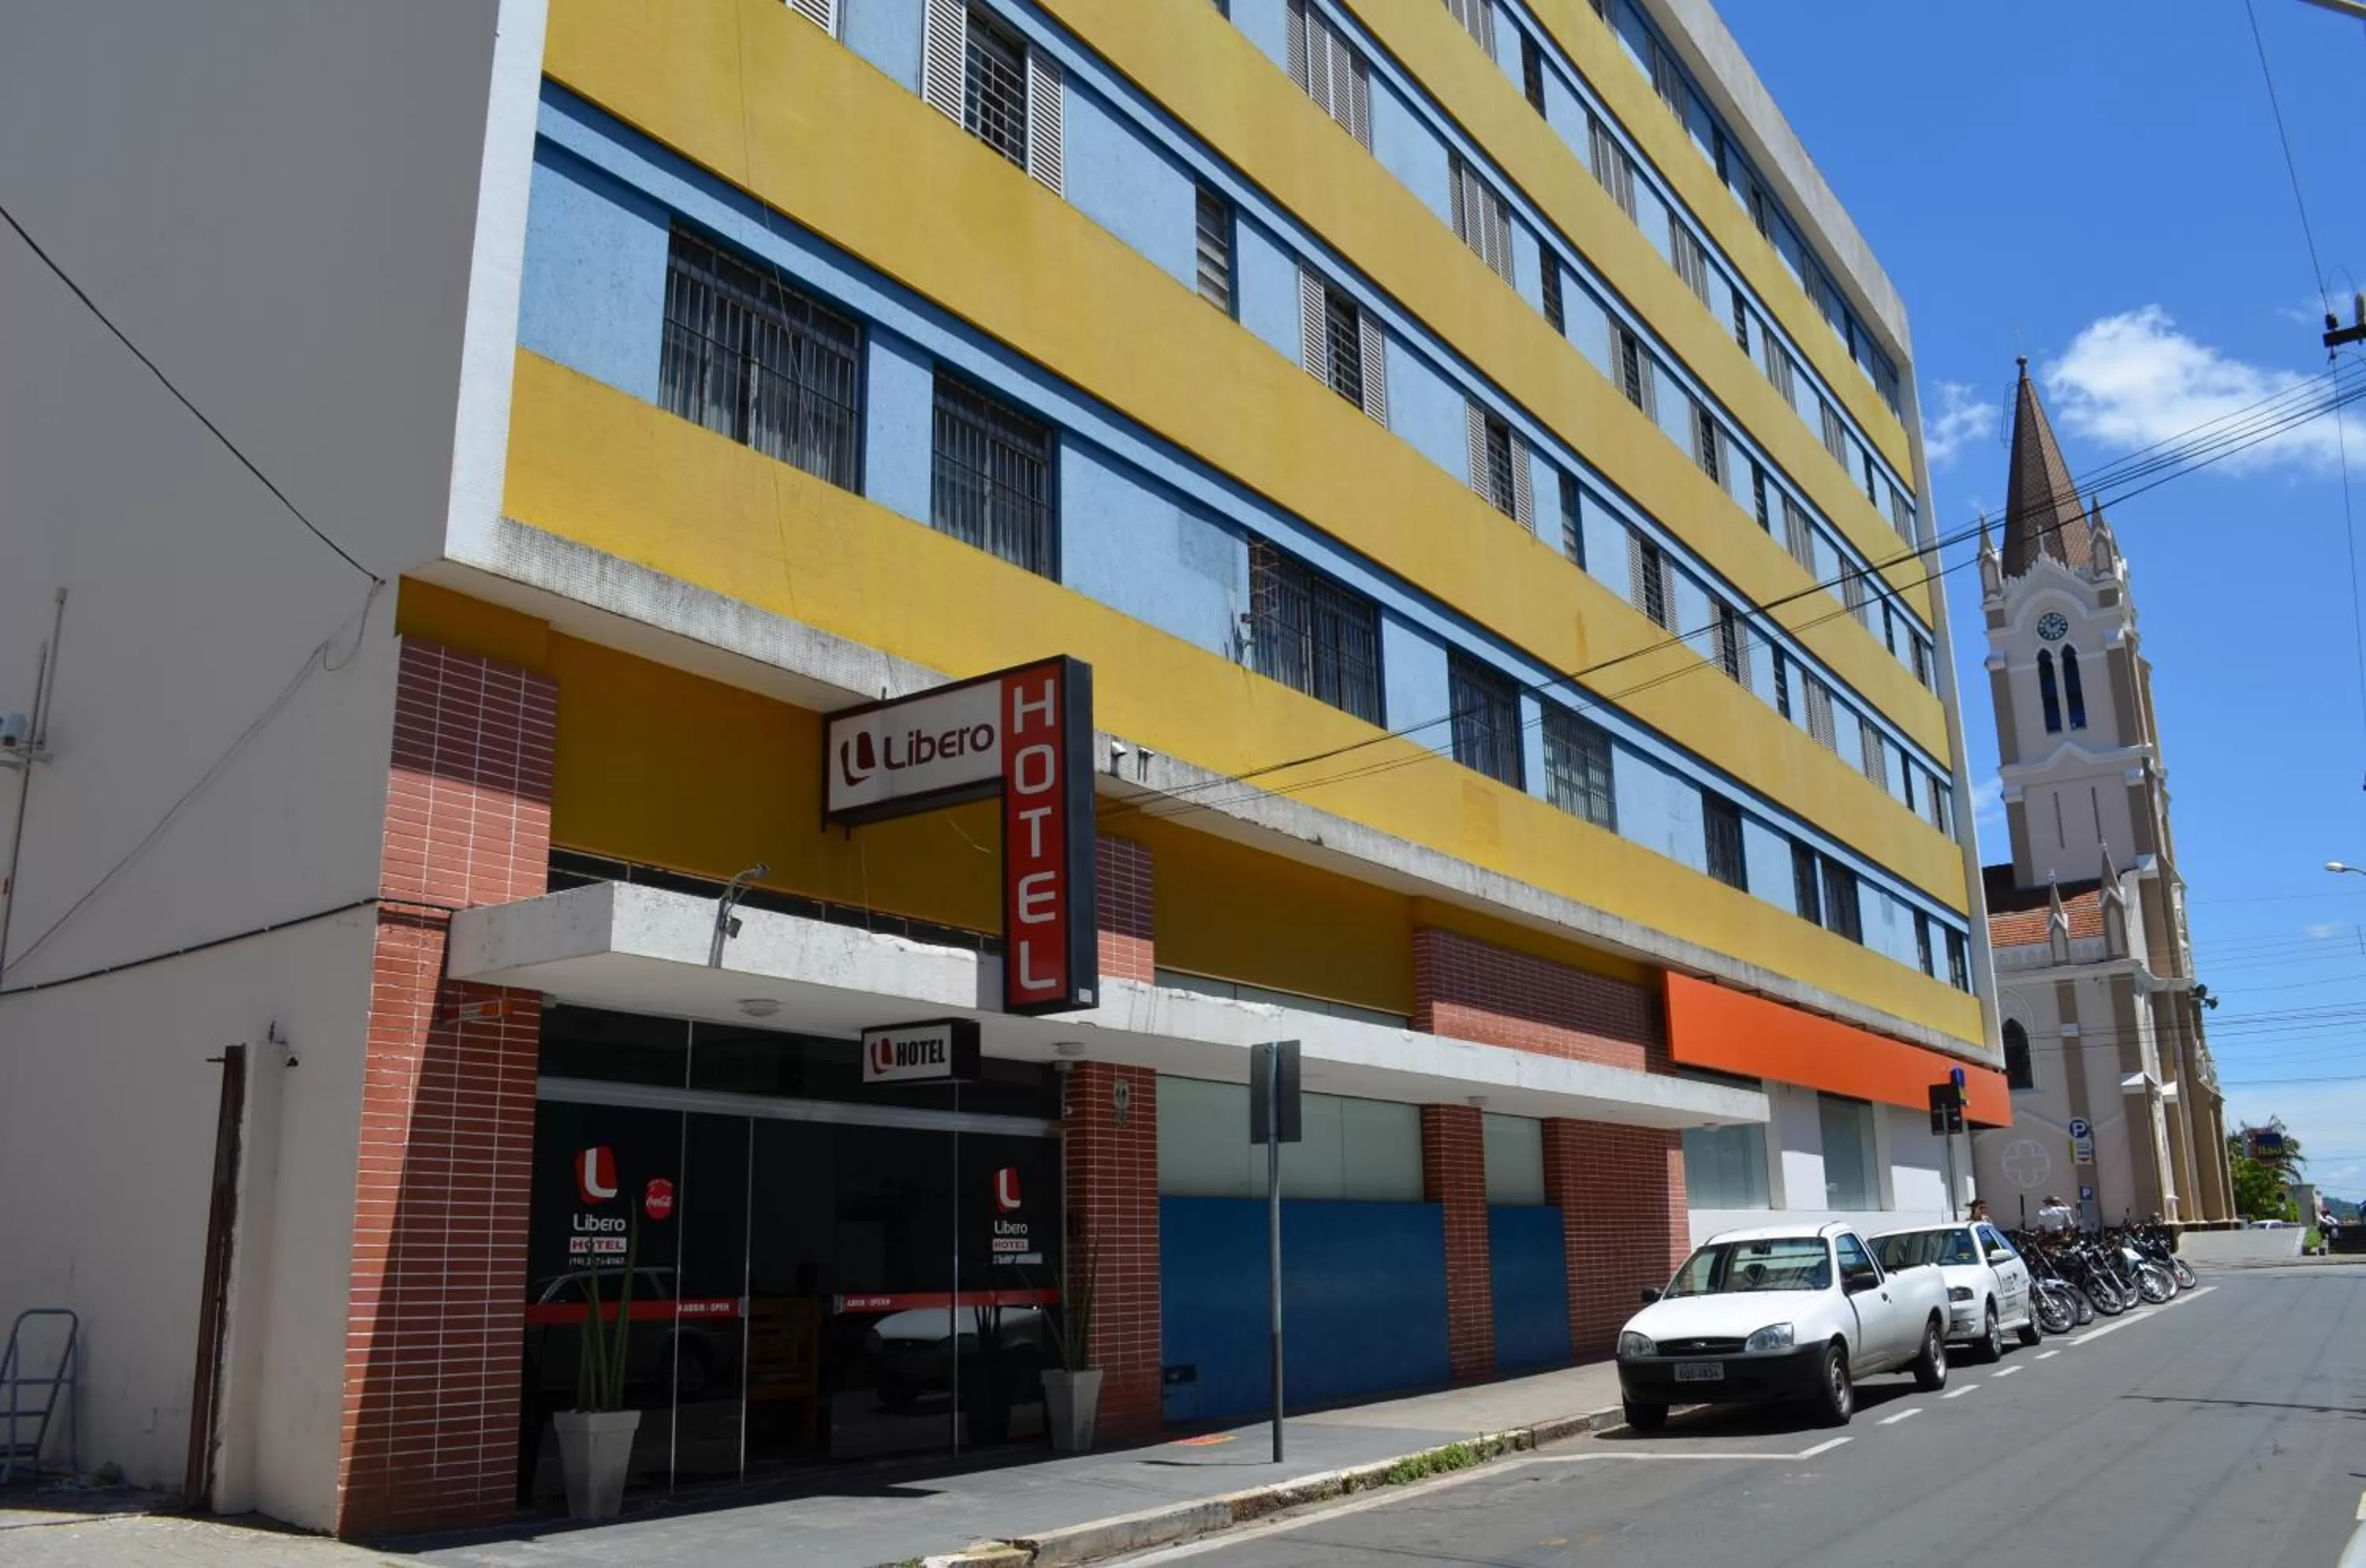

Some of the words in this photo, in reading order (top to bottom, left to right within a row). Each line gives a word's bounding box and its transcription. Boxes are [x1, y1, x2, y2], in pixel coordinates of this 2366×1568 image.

[883, 722, 995, 771] Libero
[1013, 678, 1056, 990] HOTEL
[896, 1039, 946, 1066] HOTEL
[573, 1213, 626, 1231] Libero
[995, 1220, 1028, 1234] Libero
[572, 1239, 624, 1250] HOTEL
